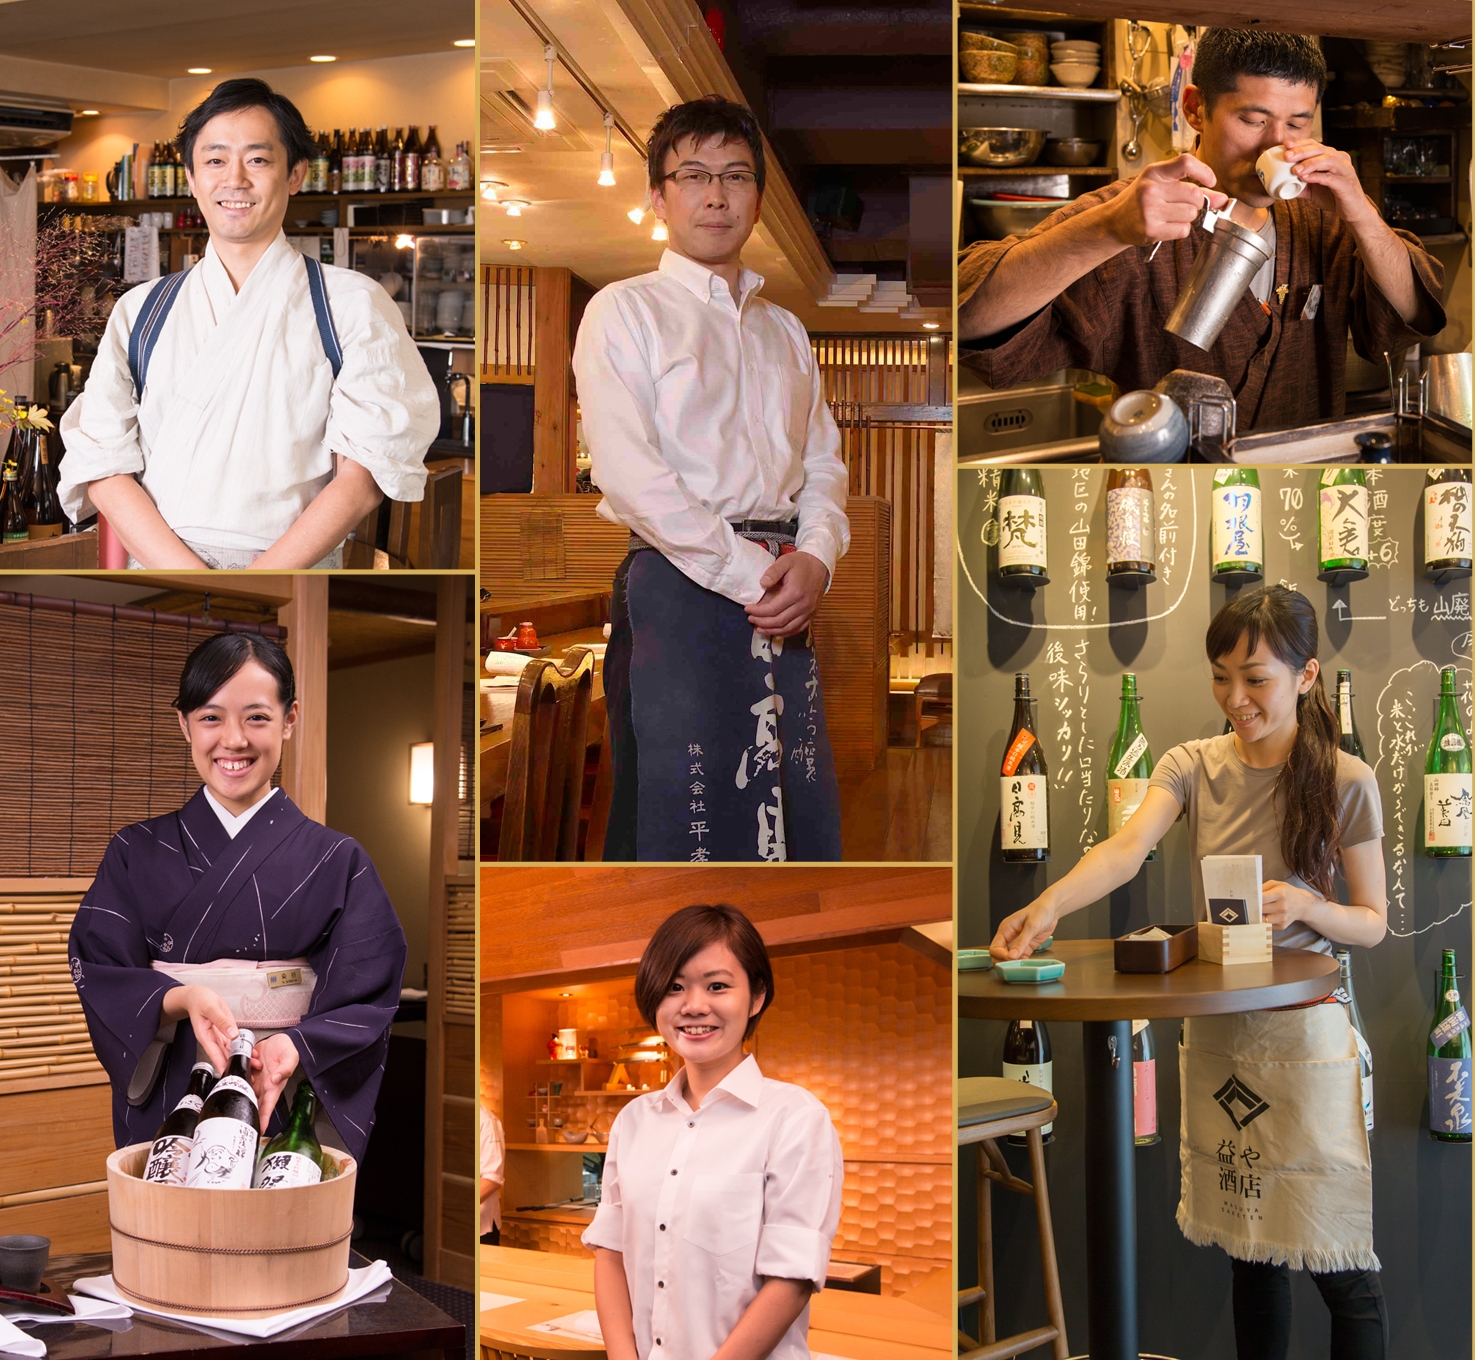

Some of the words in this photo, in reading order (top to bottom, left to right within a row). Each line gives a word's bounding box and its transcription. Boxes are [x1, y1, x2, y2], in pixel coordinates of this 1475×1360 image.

[1001, 509, 1039, 549] 梵
[1223, 491, 1254, 556] 羽根屋
[1221, 1206, 1263, 1221] SAKETEN
[1223, 1200, 1259, 1214] MASUYA
